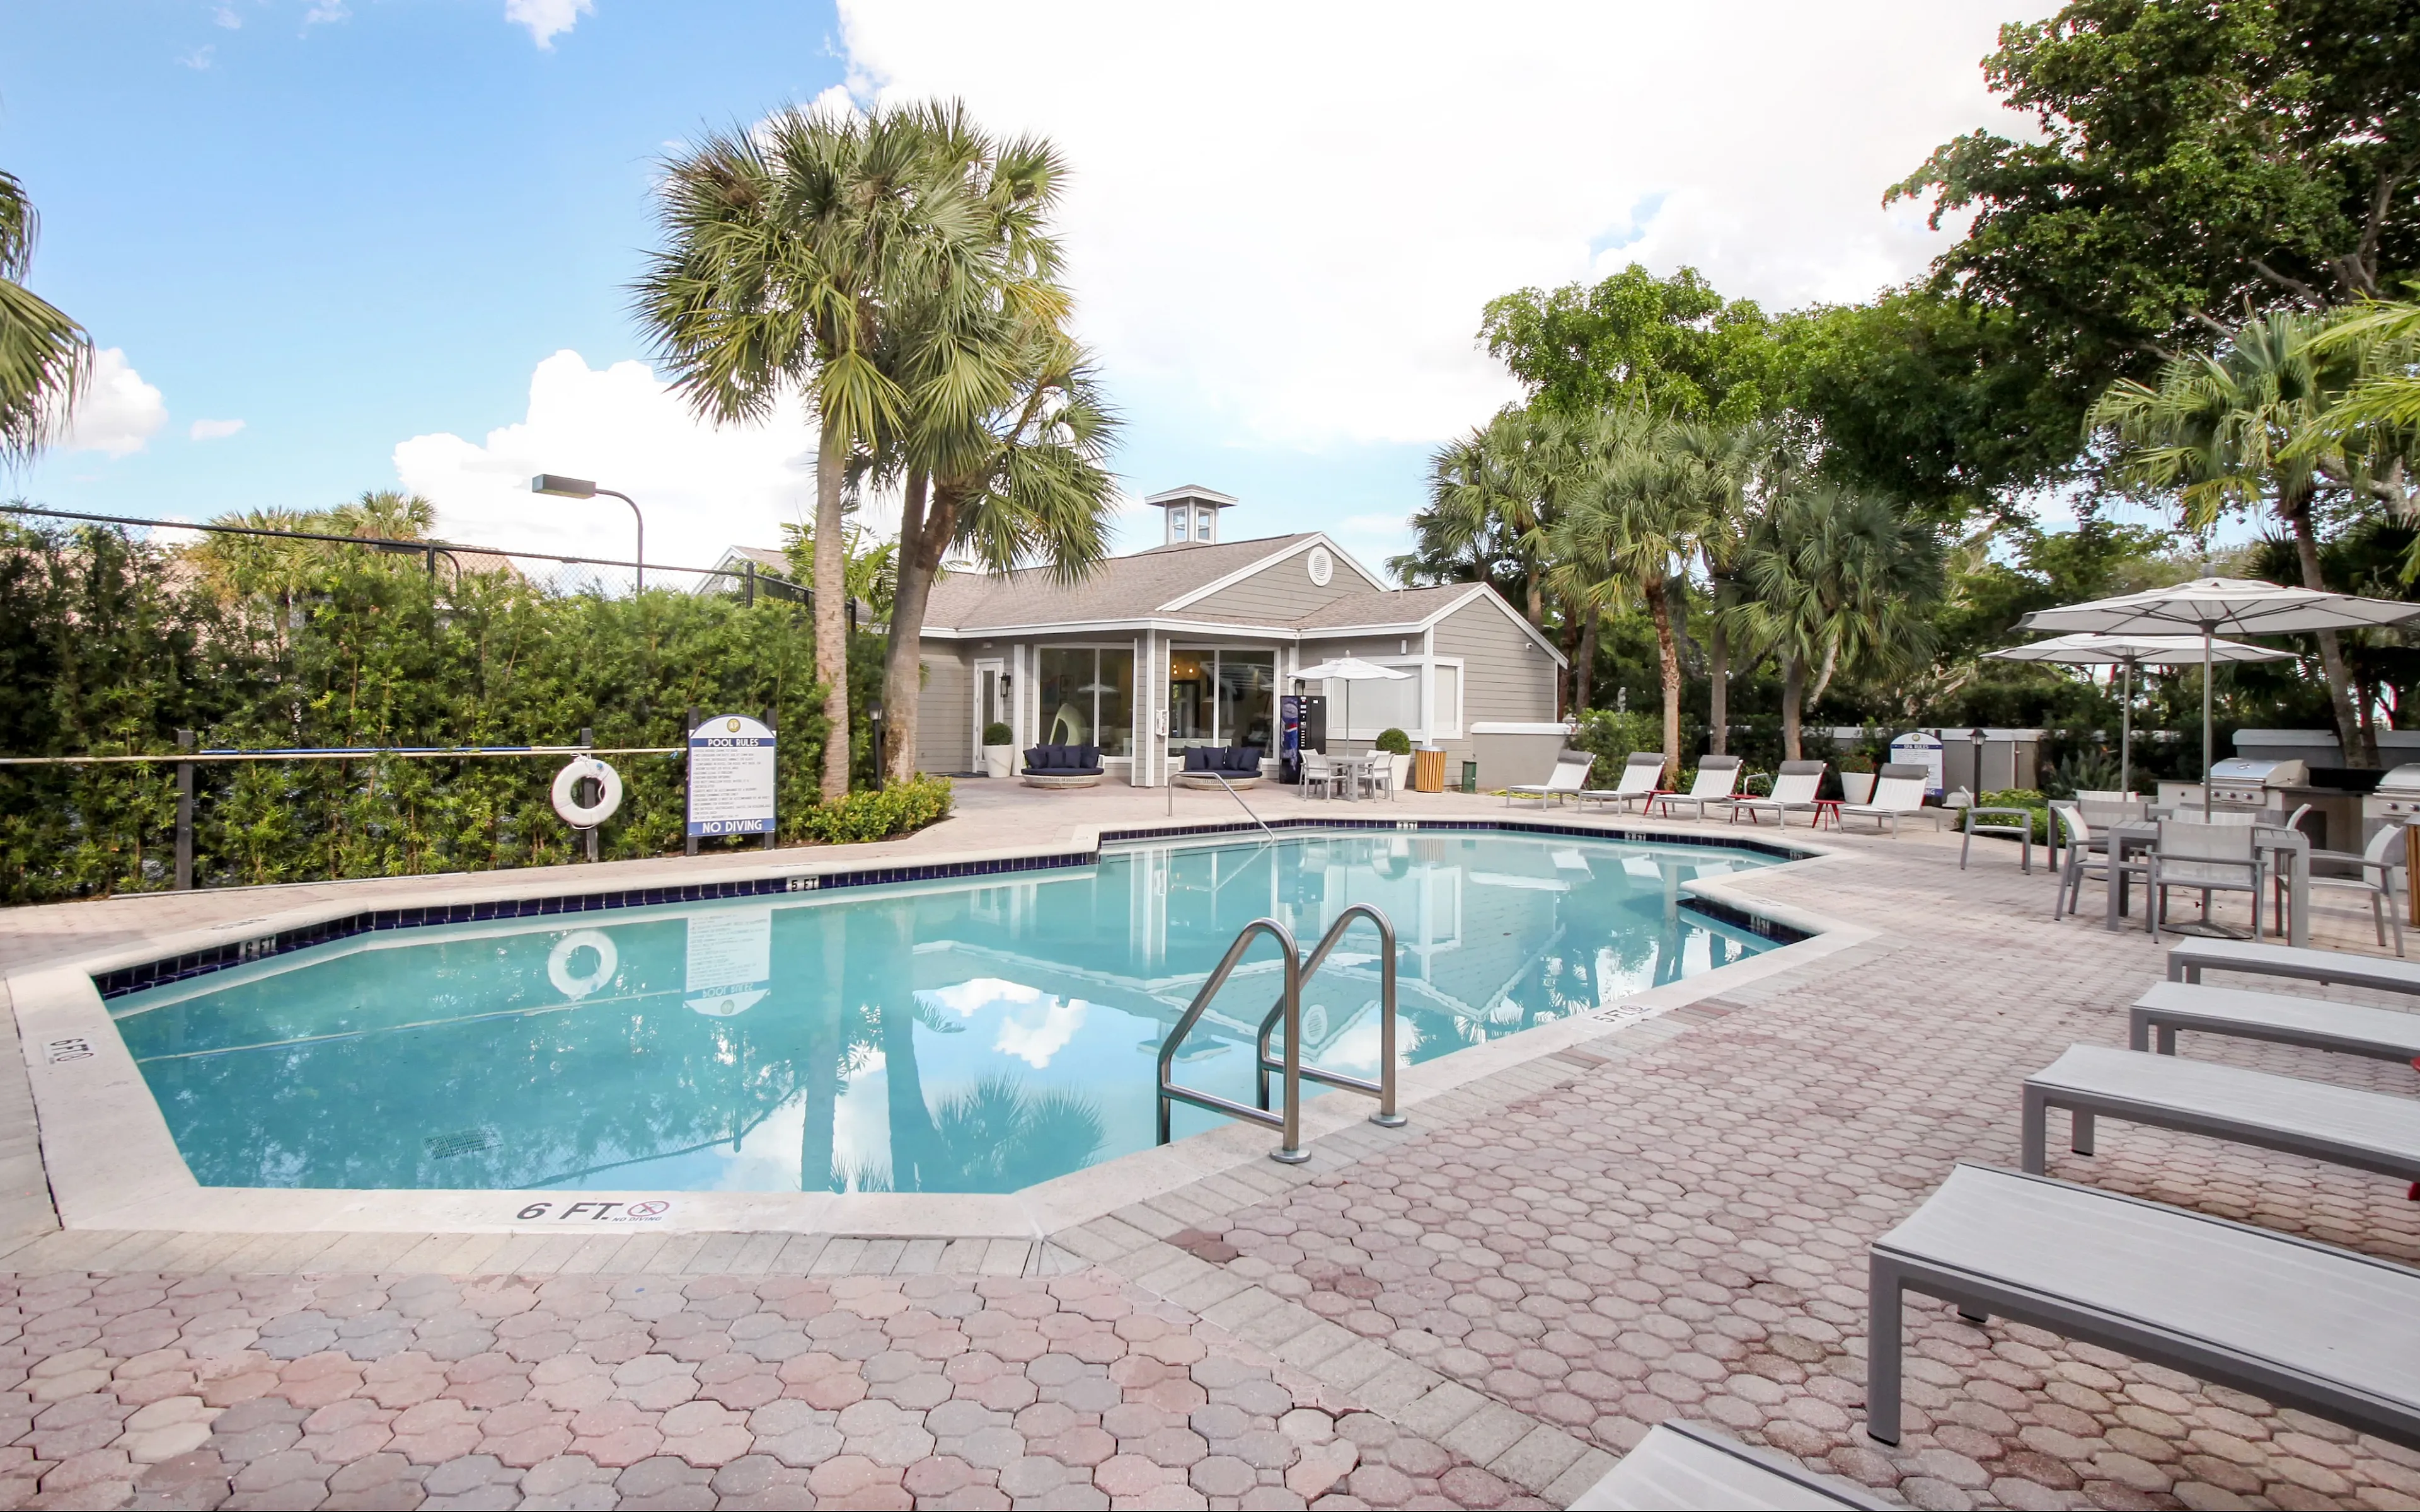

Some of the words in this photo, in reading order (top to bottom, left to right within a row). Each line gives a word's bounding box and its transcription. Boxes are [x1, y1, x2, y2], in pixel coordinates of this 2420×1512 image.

[736, 738, 759, 747] RULES
[703, 822, 721, 833] NO
[725, 820, 763, 832] DIVING
[791, 879, 798, 892] 5
[804, 878, 817, 891] FT
[259, 936, 275, 954] FT
[517, 1202, 553, 1220] 6
[559, 1202, 624, 1220] FT.
